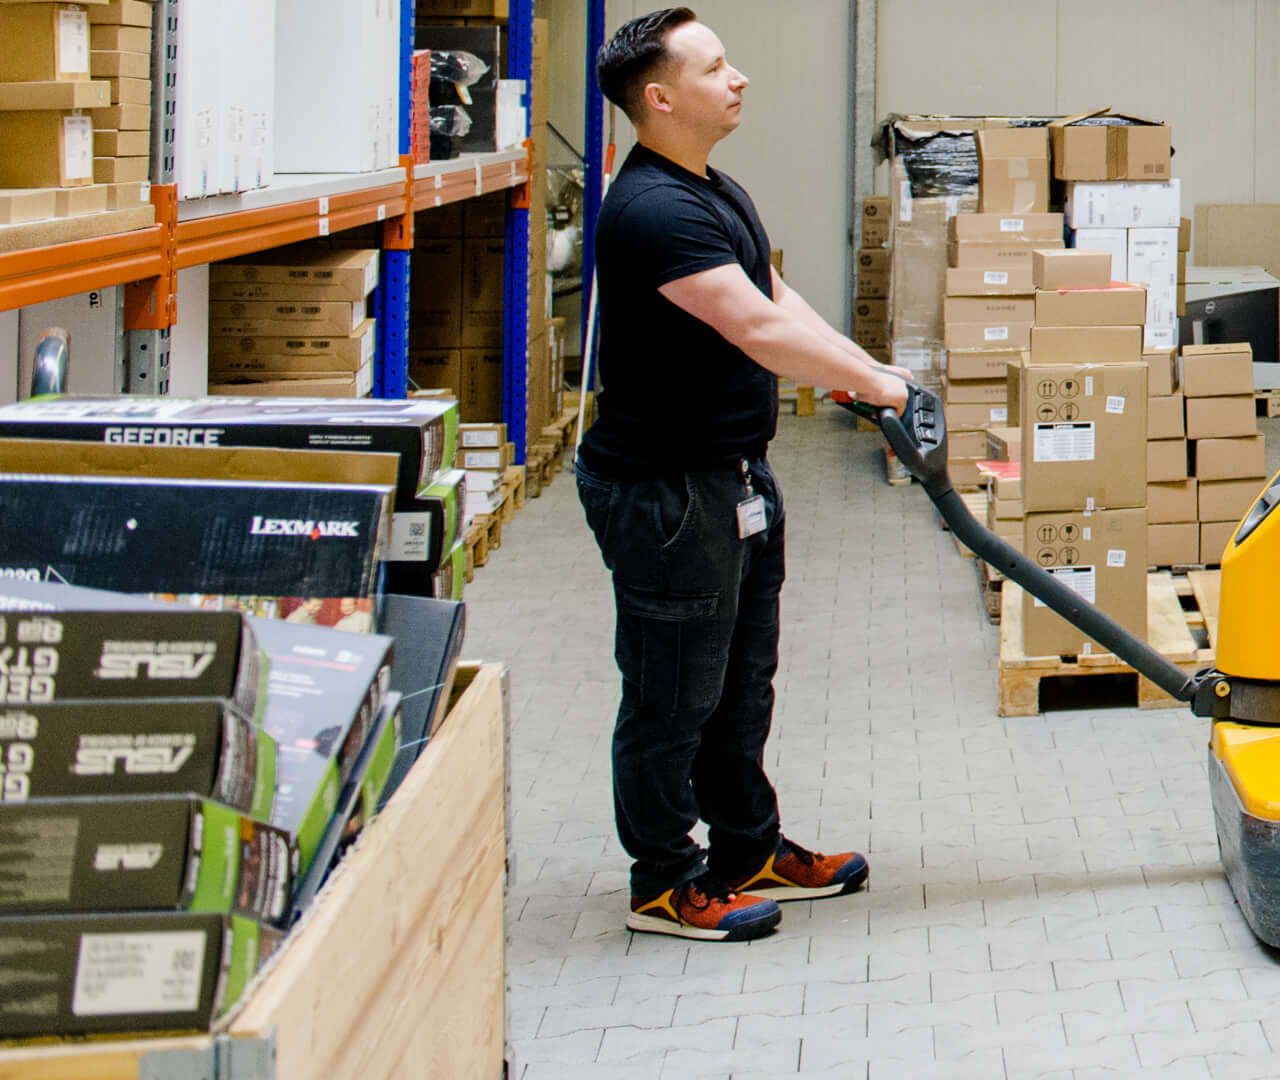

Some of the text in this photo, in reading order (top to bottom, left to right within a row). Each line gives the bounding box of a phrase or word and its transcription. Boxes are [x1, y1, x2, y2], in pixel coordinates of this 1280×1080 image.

[104, 427, 220, 447] GEFORCE
[250, 516, 360, 541] LEXMARK
[95, 651, 216, 680] ASUS
[74, 746, 195, 775] ASUS
